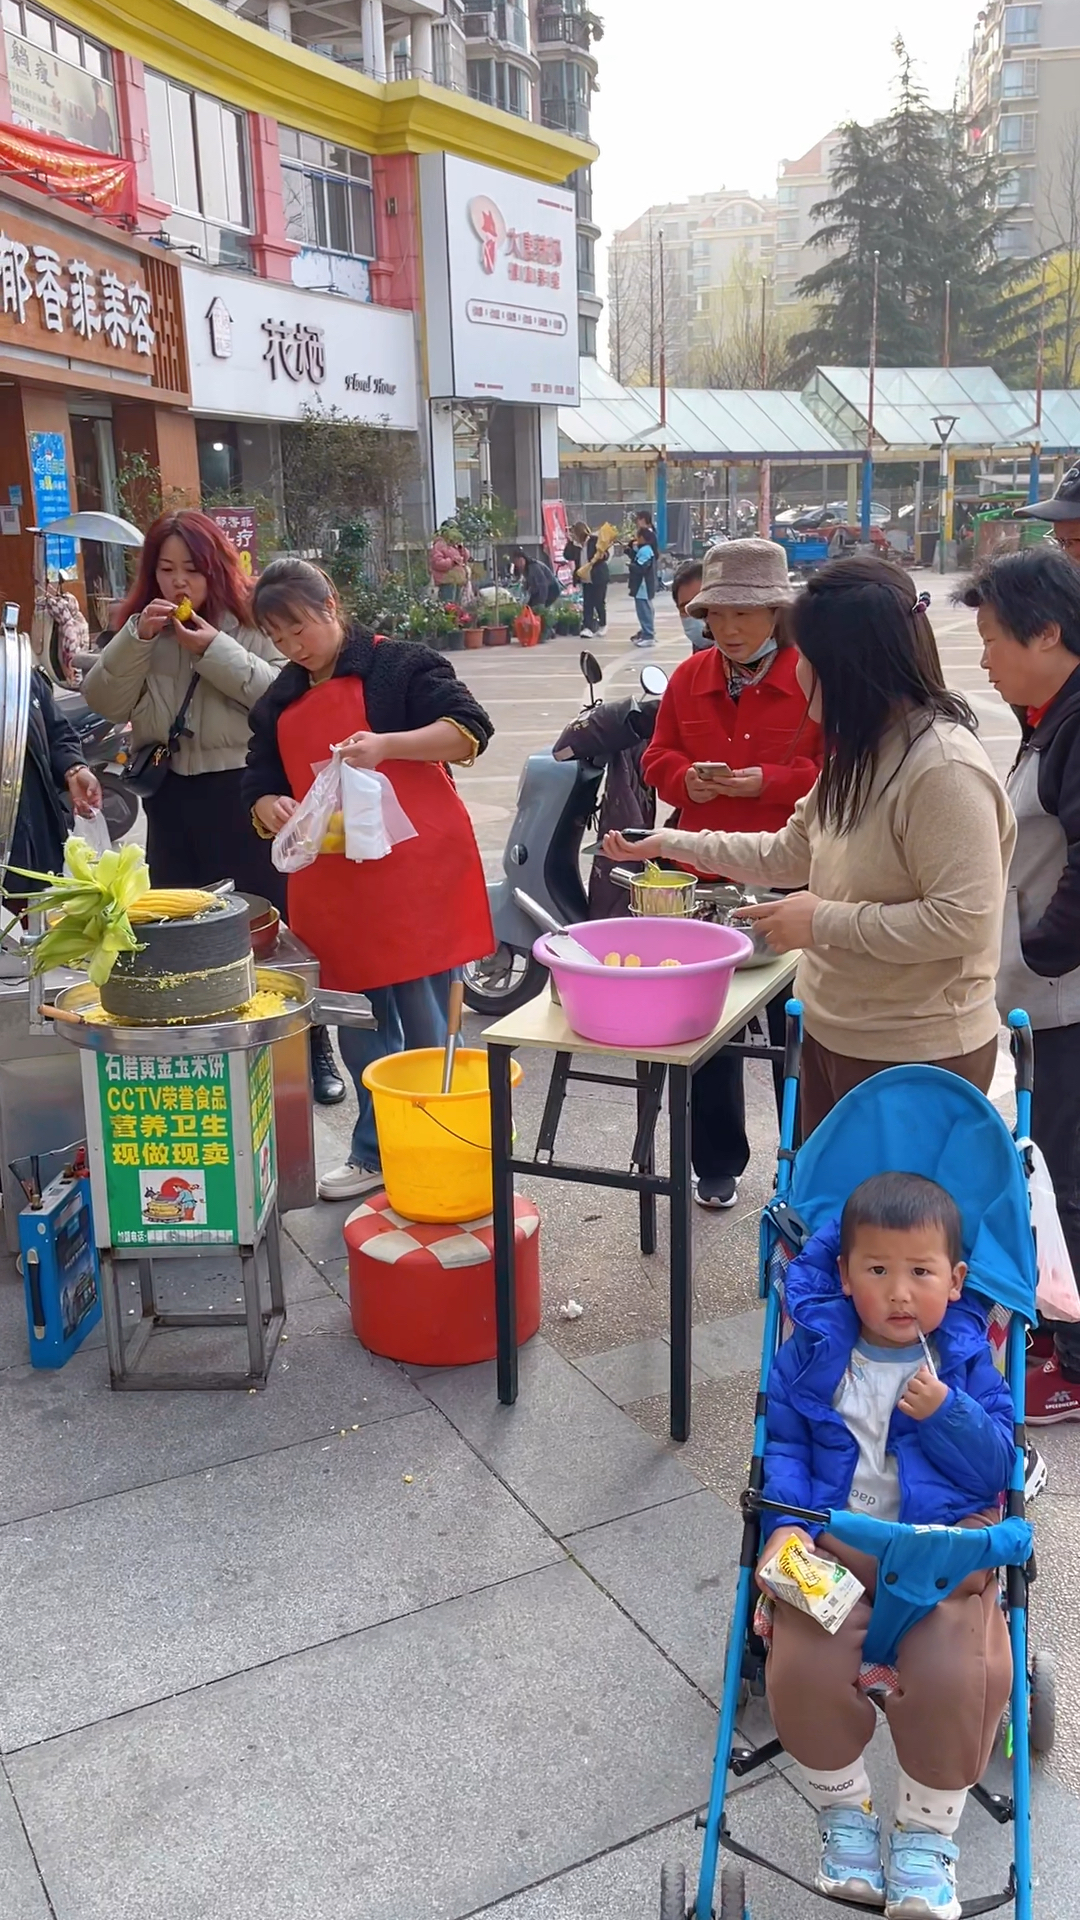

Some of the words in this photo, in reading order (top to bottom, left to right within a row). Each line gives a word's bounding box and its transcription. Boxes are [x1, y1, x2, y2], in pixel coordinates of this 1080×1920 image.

[105, 1053, 225, 1080] 石磨黄金玉米饼
[107, 1085, 228, 1112] CCTV荣誉食品
[110, 1114, 229, 1139] 营养卫生
[112, 1142, 230, 1166] 现做现卖
